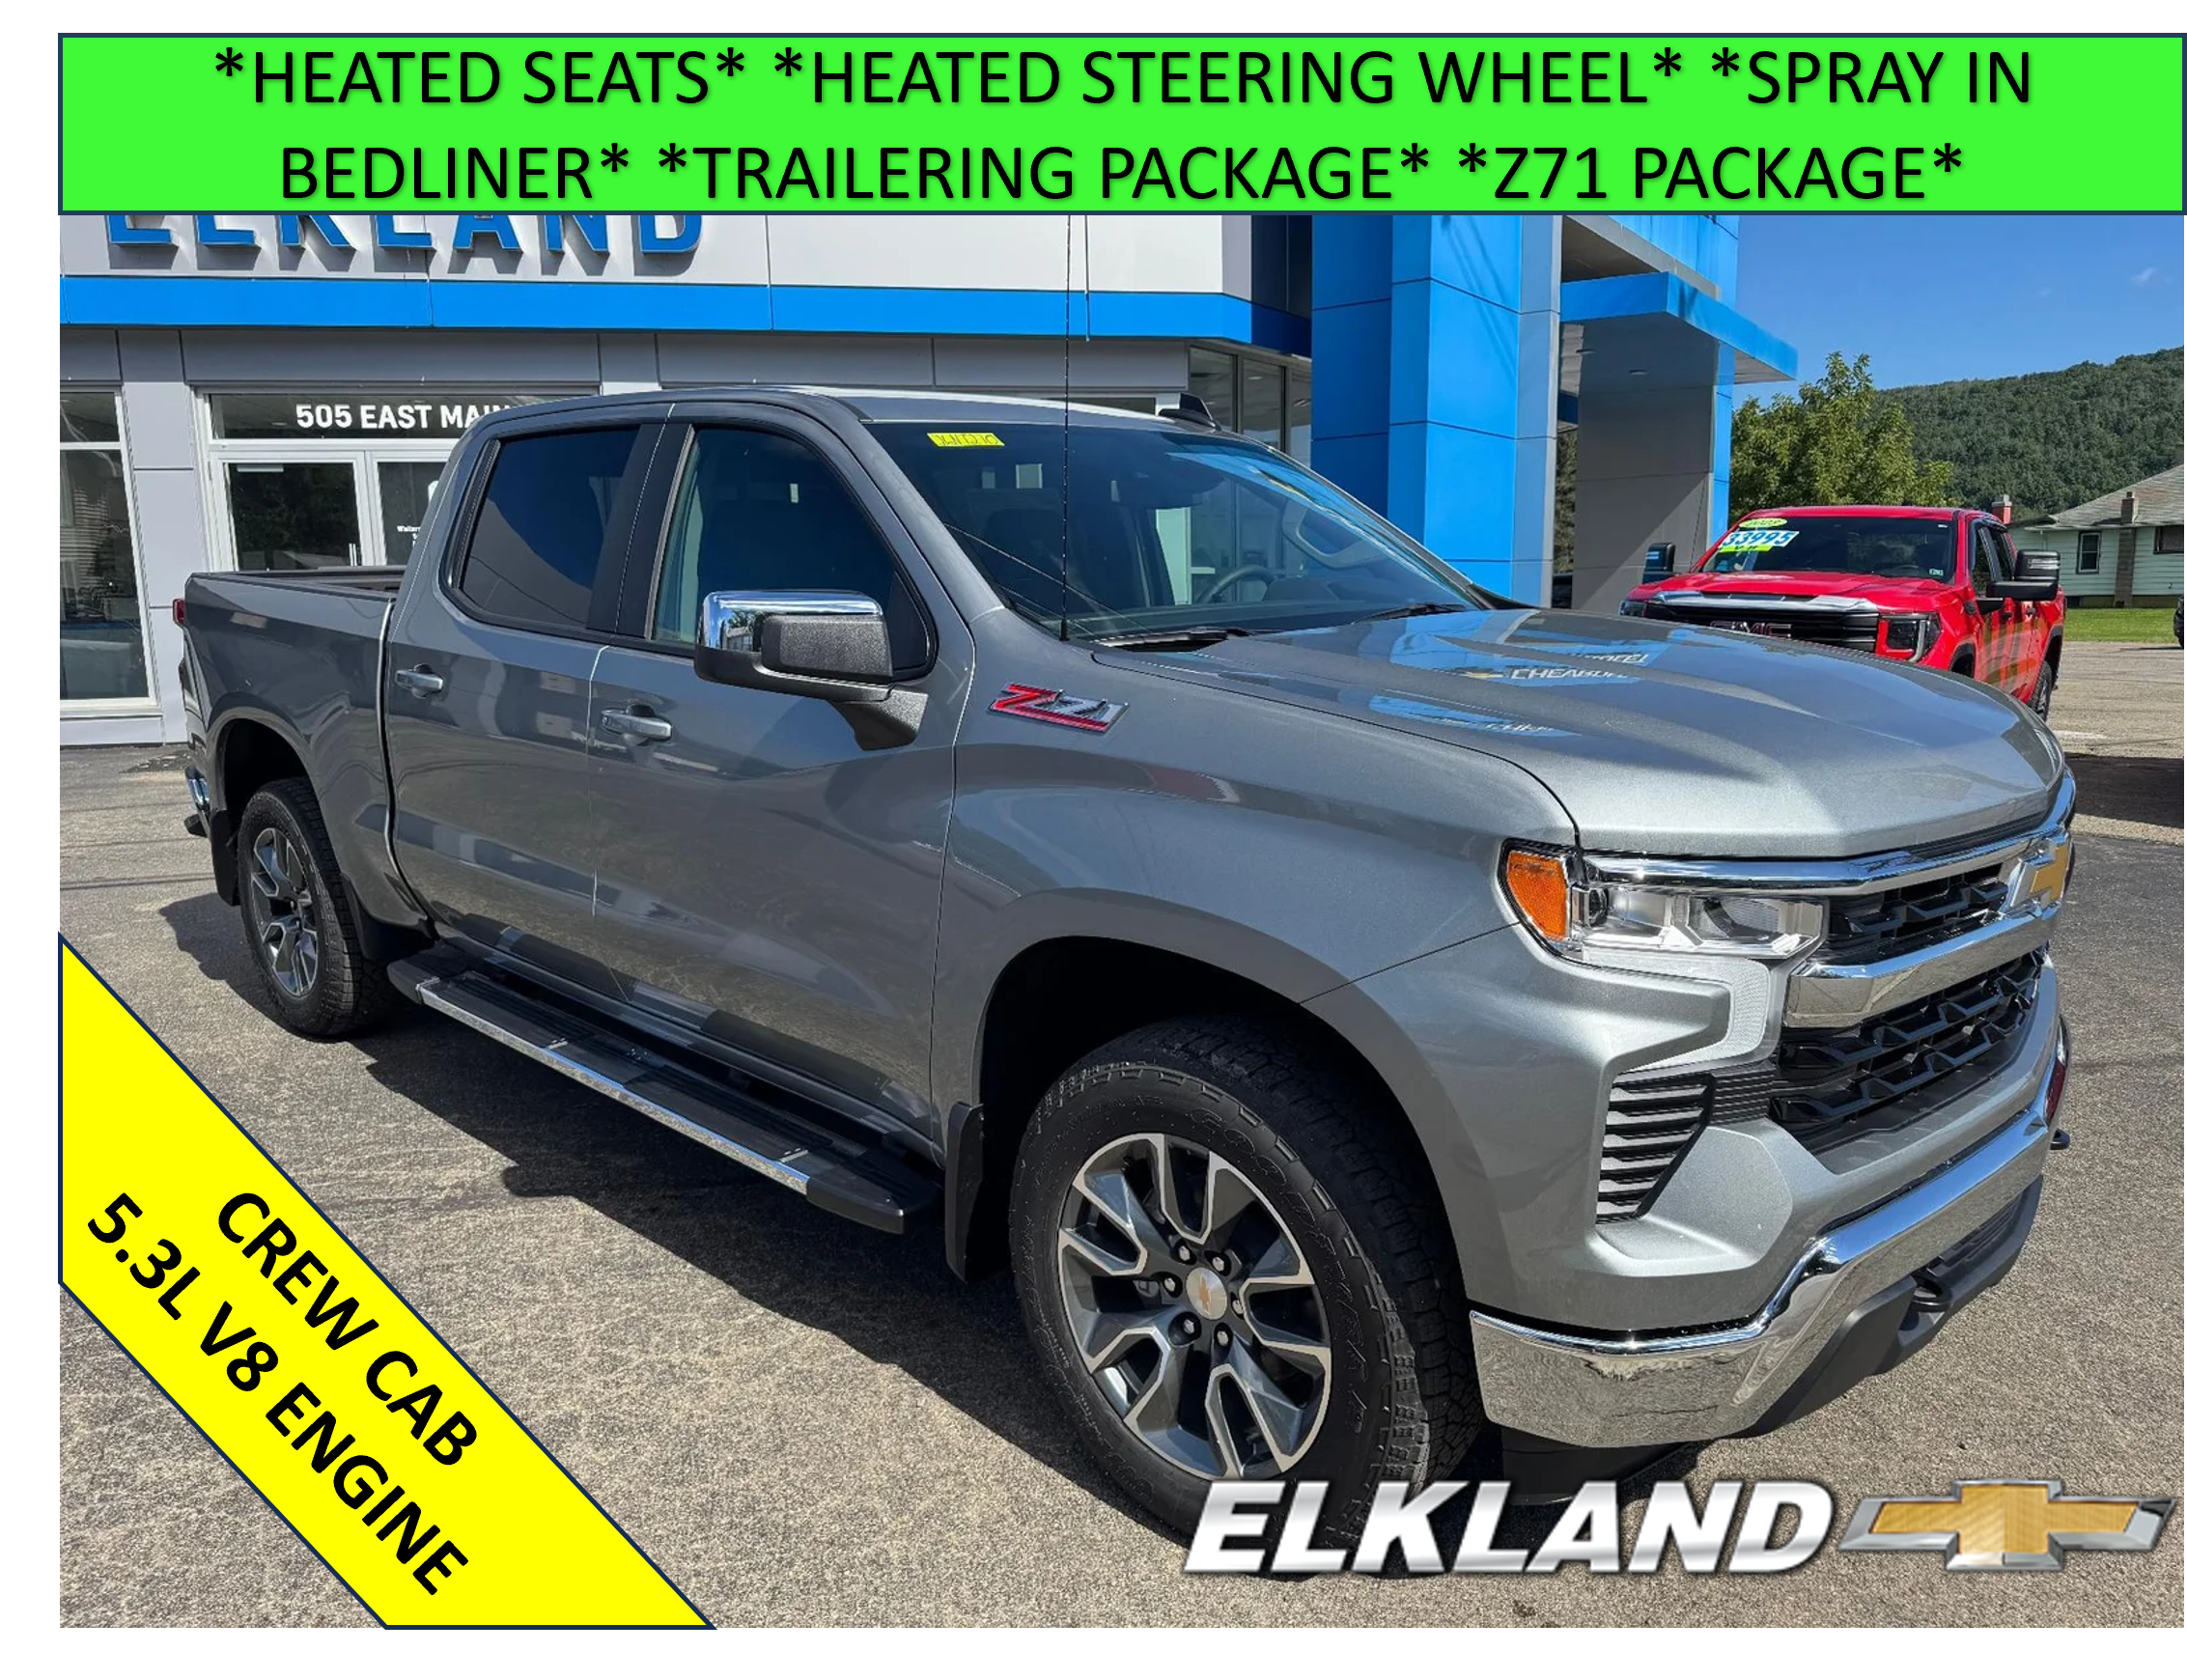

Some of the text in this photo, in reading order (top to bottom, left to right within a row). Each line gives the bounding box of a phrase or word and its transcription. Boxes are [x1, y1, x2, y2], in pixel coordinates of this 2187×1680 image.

[295, 404, 512, 429] 505 EAST MA
[989, 683, 1130, 733] Z71
